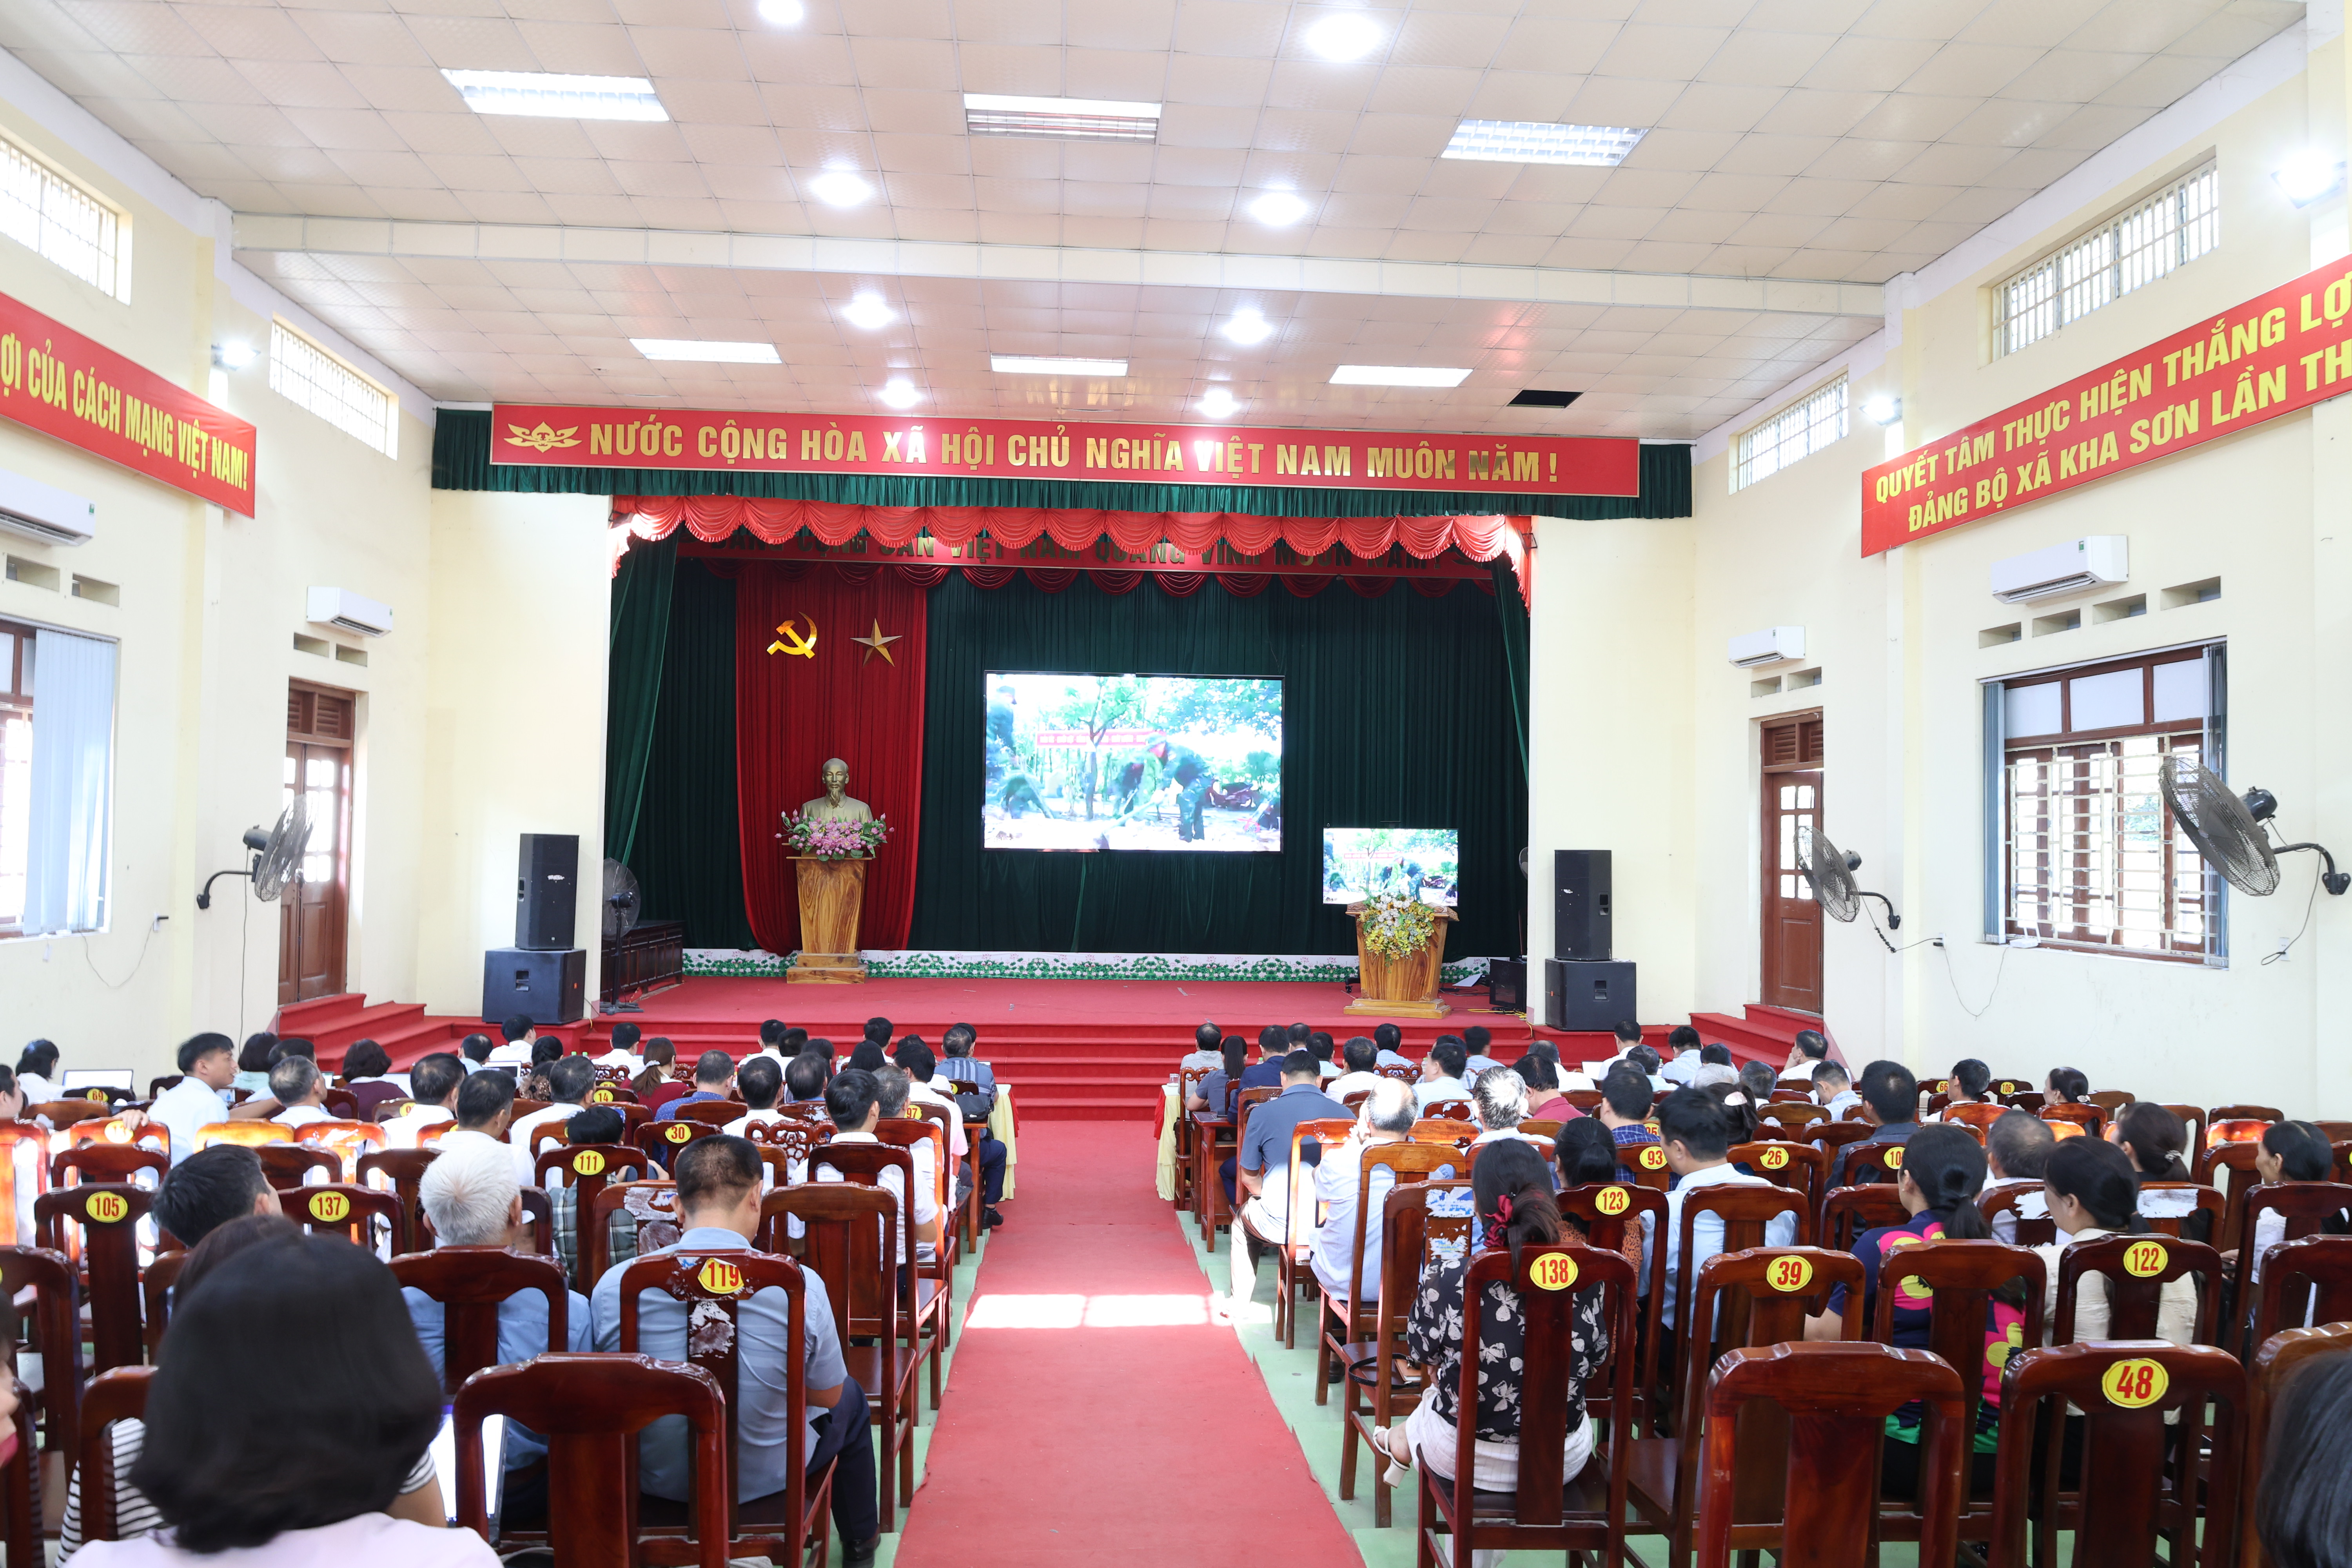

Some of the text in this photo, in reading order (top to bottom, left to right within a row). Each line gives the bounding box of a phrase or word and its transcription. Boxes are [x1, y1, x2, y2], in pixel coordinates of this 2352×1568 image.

[28, 338, 67, 410] CỦA
[73, 367, 121, 434] CÁCH
[125, 394, 173, 457] MẠNG
[178, 419, 209, 478] VIỆT
[211, 436, 248, 491] NAM!
[1876, 448, 1939, 503] QUYẾT
[1945, 432, 1995, 474] TÂM
[2003, 400, 2070, 452] THỰC
[2080, 363, 2152, 422] HIỆN
[2163, 307, 2286, 387] THẮNG
[590, 414, 683, 457] NƯỚC
[698, 419, 787, 464] CỘNG
[801, 422, 867, 462] HÒA
[881, 425, 927, 464] XÃ
[942, 426, 995, 470] HỘI
[1007, 425, 1069, 467] CHỦ
[1086, 432, 1184, 472] NGHĨA
[1194, 435, 1264, 479] VIỆT
[1277, 444, 1351, 476] NAM
[1367, 441, 1455, 479] MUÔN
[1468, 443, 1539, 482] NĂM
[1908, 487, 1968, 532] ĐẢNG
[1976, 467, 2008, 509] BỘ
[2016, 450, 2052, 495] XÃ
[2061, 431, 2120, 479] KHA
[2130, 399, 2199, 453] SƠN
[2212, 364, 2287, 426] LẦN
[598, 1093, 608, 1102] 14
[2002, 1084, 2012, 1093] 106
[906, 1108, 918, 1118] 97
[670, 1126, 685, 1140] 30
[579, 1155, 597, 1171] 111
[1648, 1150, 1663, 1165] 93
[1767, 1150, 1782, 1165] 26
[1890, 1151, 1902, 1165] 10
[94, 1197, 120, 1217] 105
[317, 1197, 341, 1216] 137
[1602, 1192, 1623, 1210] 123
[2132, 1247, 2159, 1272] 122
[708, 1262, 739, 1287] 119
[1539, 1259, 1569, 1285] 138
[1777, 1261, 1802, 1286] 39
[2116, 1365, 2154, 1399] 48
